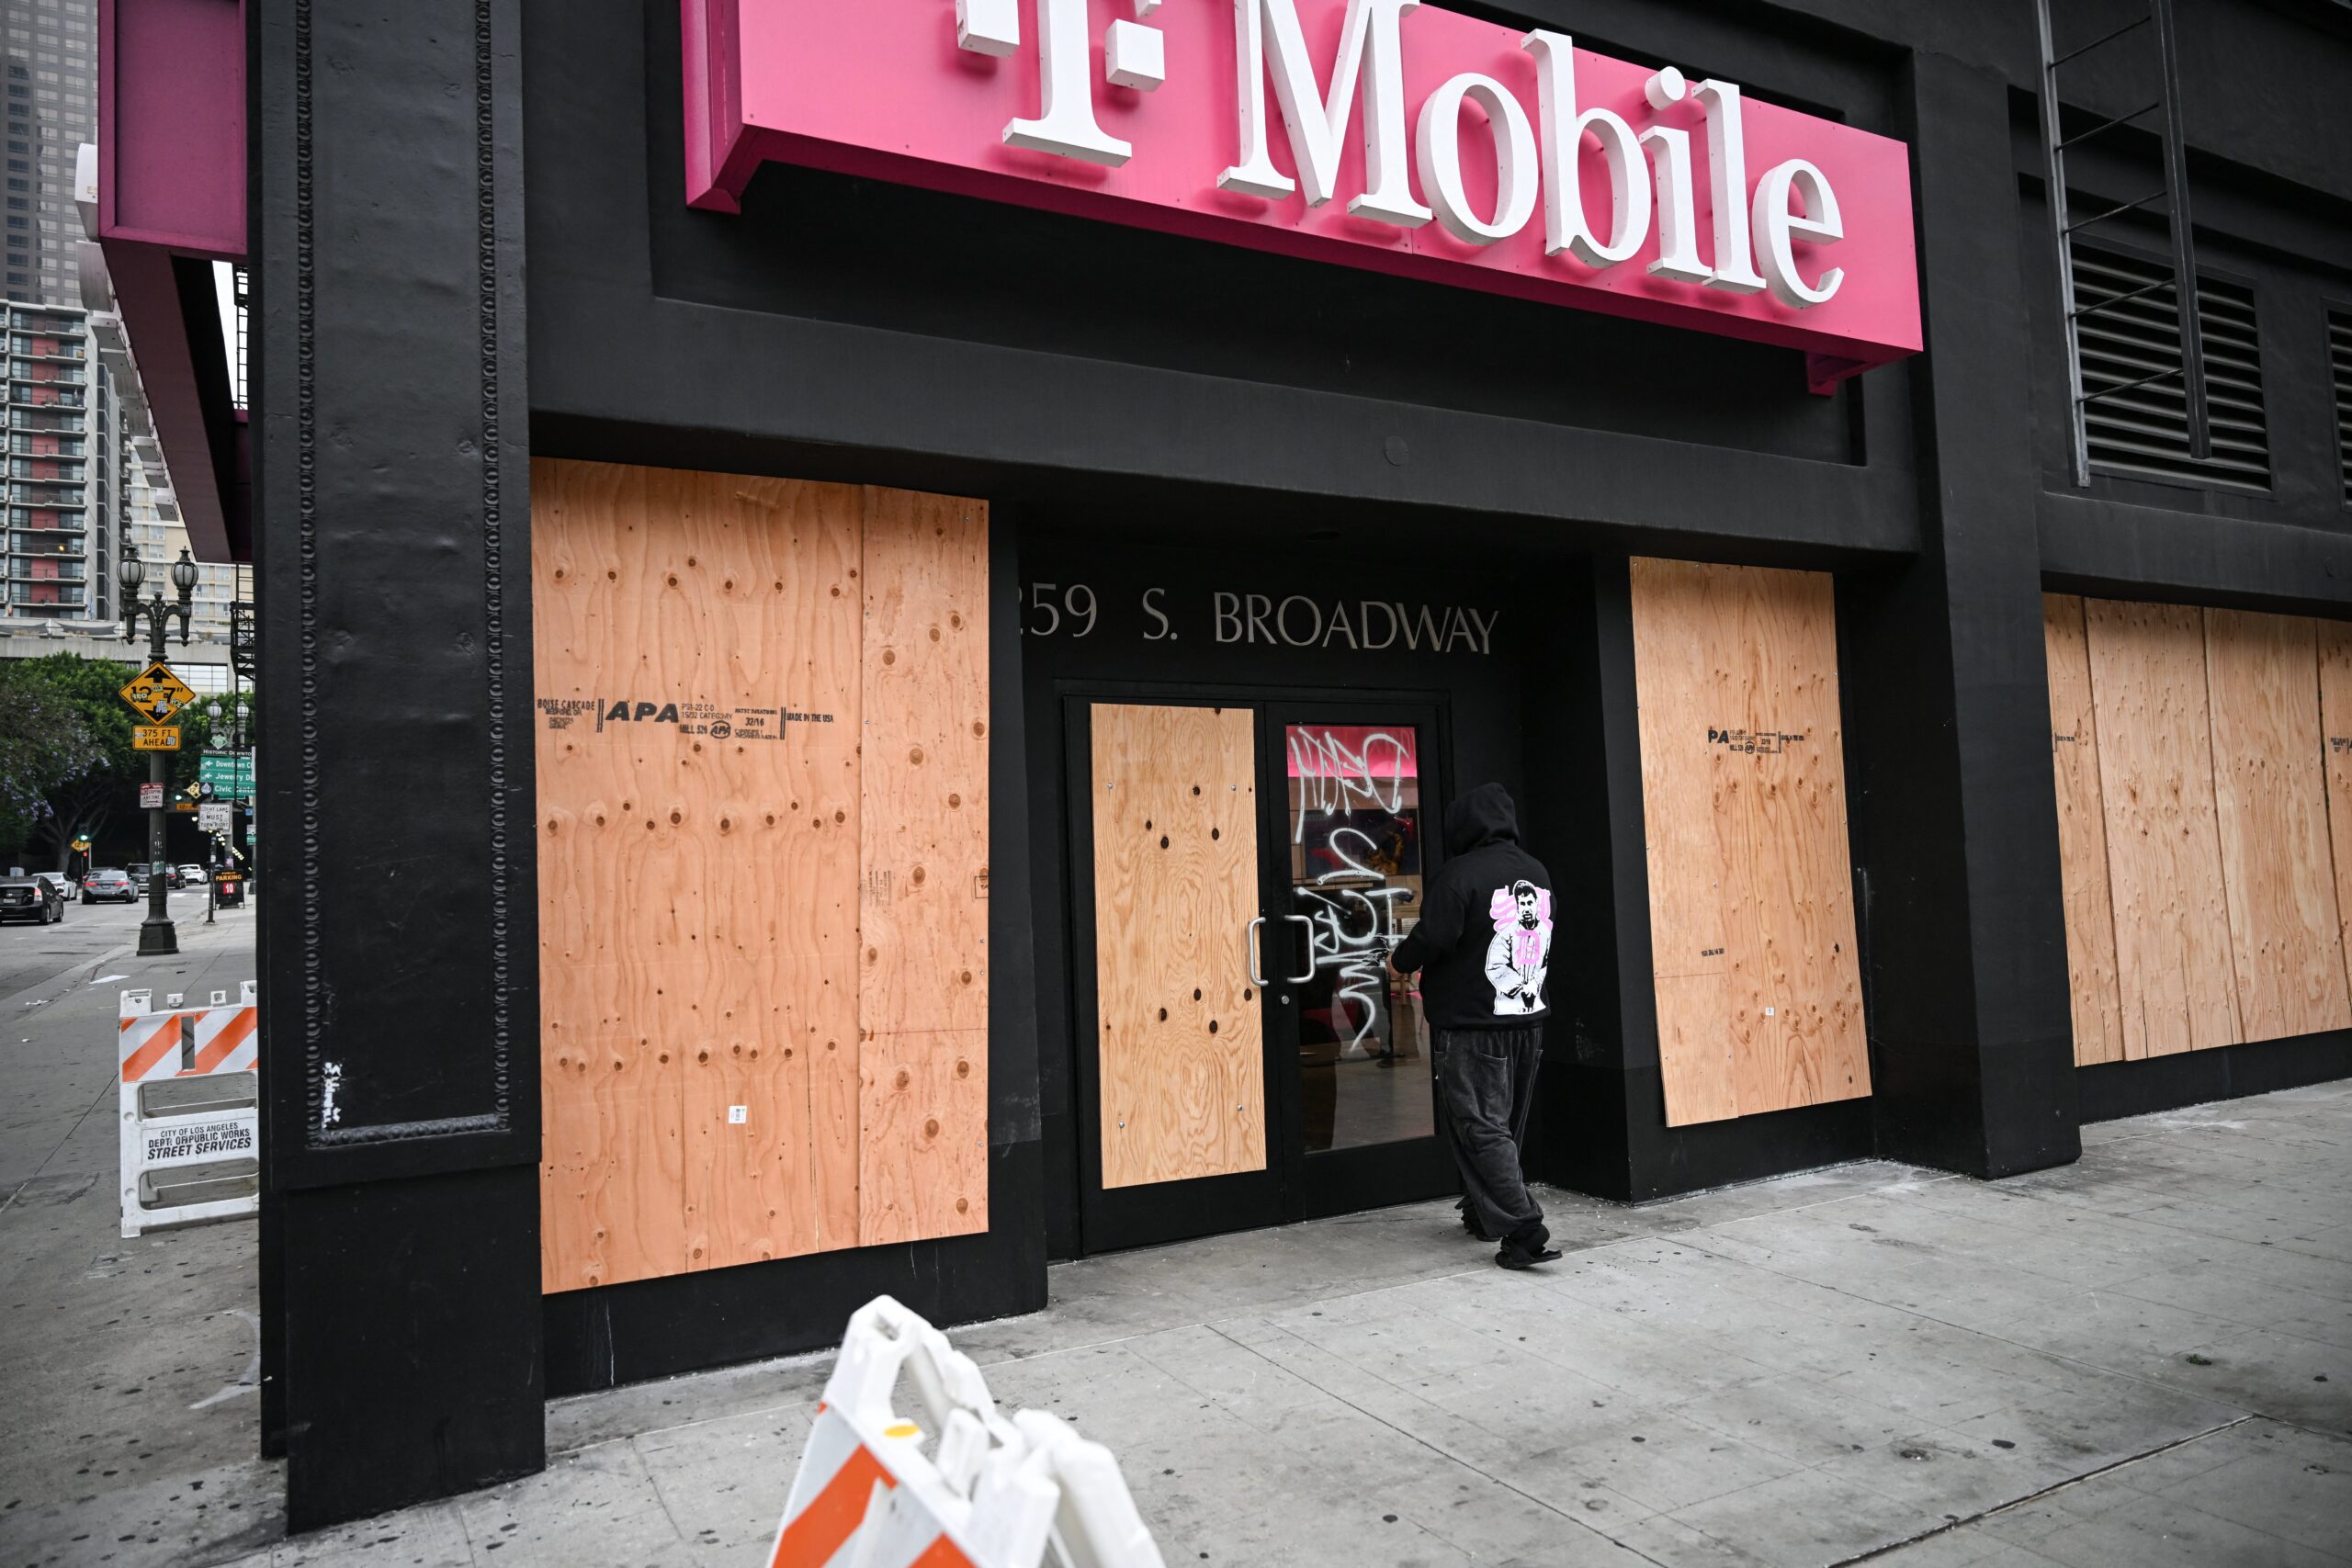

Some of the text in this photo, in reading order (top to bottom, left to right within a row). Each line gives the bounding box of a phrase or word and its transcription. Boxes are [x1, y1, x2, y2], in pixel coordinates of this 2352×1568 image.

[1217, 0, 1844, 310] Mobile
[1019, 582, 1499, 654] 59 S. BROADWAY
[537, 698, 595, 711] BOISE CASCADE
[605, 701, 679, 723] APA
[699, 712, 733, 720] CATEGORY
[745, 717, 764, 727] 32/16
[811, 713, 821, 722] THE
[822, 714, 833, 723] USA
[143, 738, 173, 746] AHEA
[216, 761, 245, 769] Downtwn
[215, 773, 243, 782] Jewery
[226, 884, 233, 893] 10
[161, 1122, 239, 1138] CITY OF LOS ANGELES
[188, 1132, 219, 1144] PUBLIC
[220, 1128, 250, 1140] WORKS
[147, 1137, 252, 1160] STREET SERVICES
